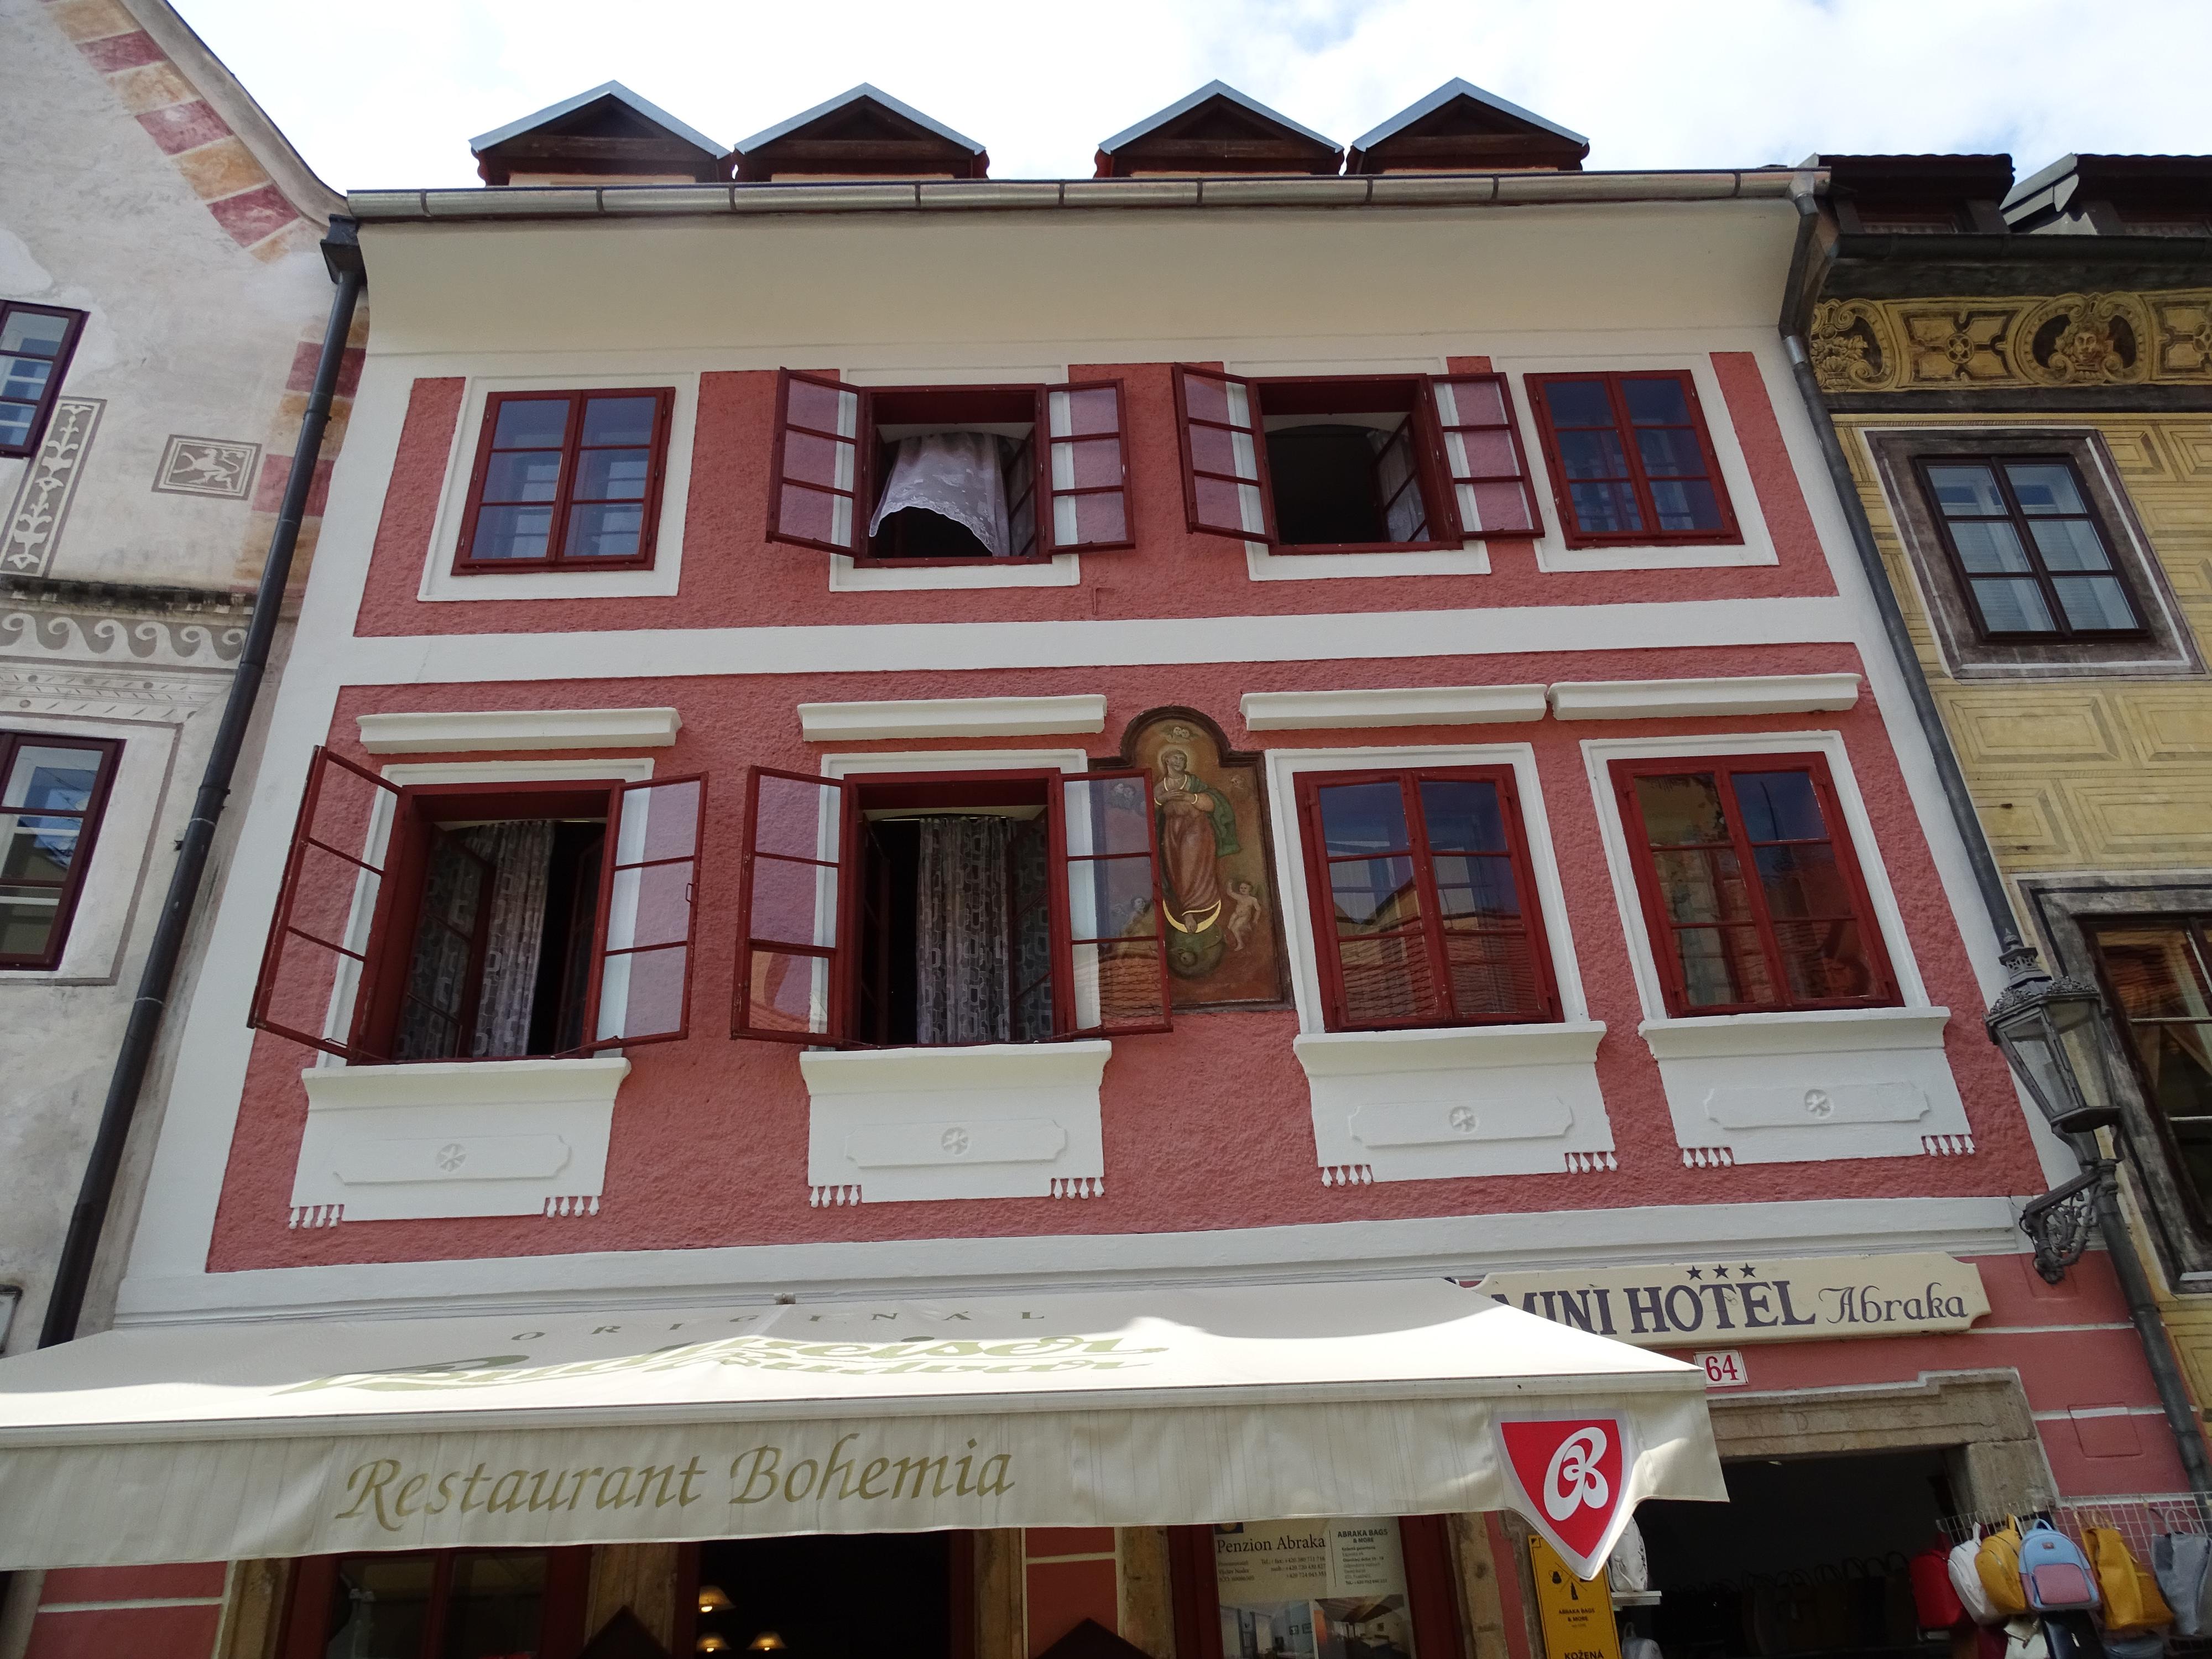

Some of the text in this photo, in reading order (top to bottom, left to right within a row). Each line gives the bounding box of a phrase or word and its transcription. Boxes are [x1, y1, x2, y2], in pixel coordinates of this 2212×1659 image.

[1623, 1280, 1815, 1334] HOTEL
[1818, 1282, 1969, 1324] Abraka
[1705, 1354, 1740, 1383] 64
[335, 1433, 1016, 1532] Restaurant Bohemia
[1217, 1534, 1326, 1553] Penzion Abraka
[1338, 1530, 1367, 1538] ABRAKA
[1564, 1648, 1604, 1659] KOŽENÁ
